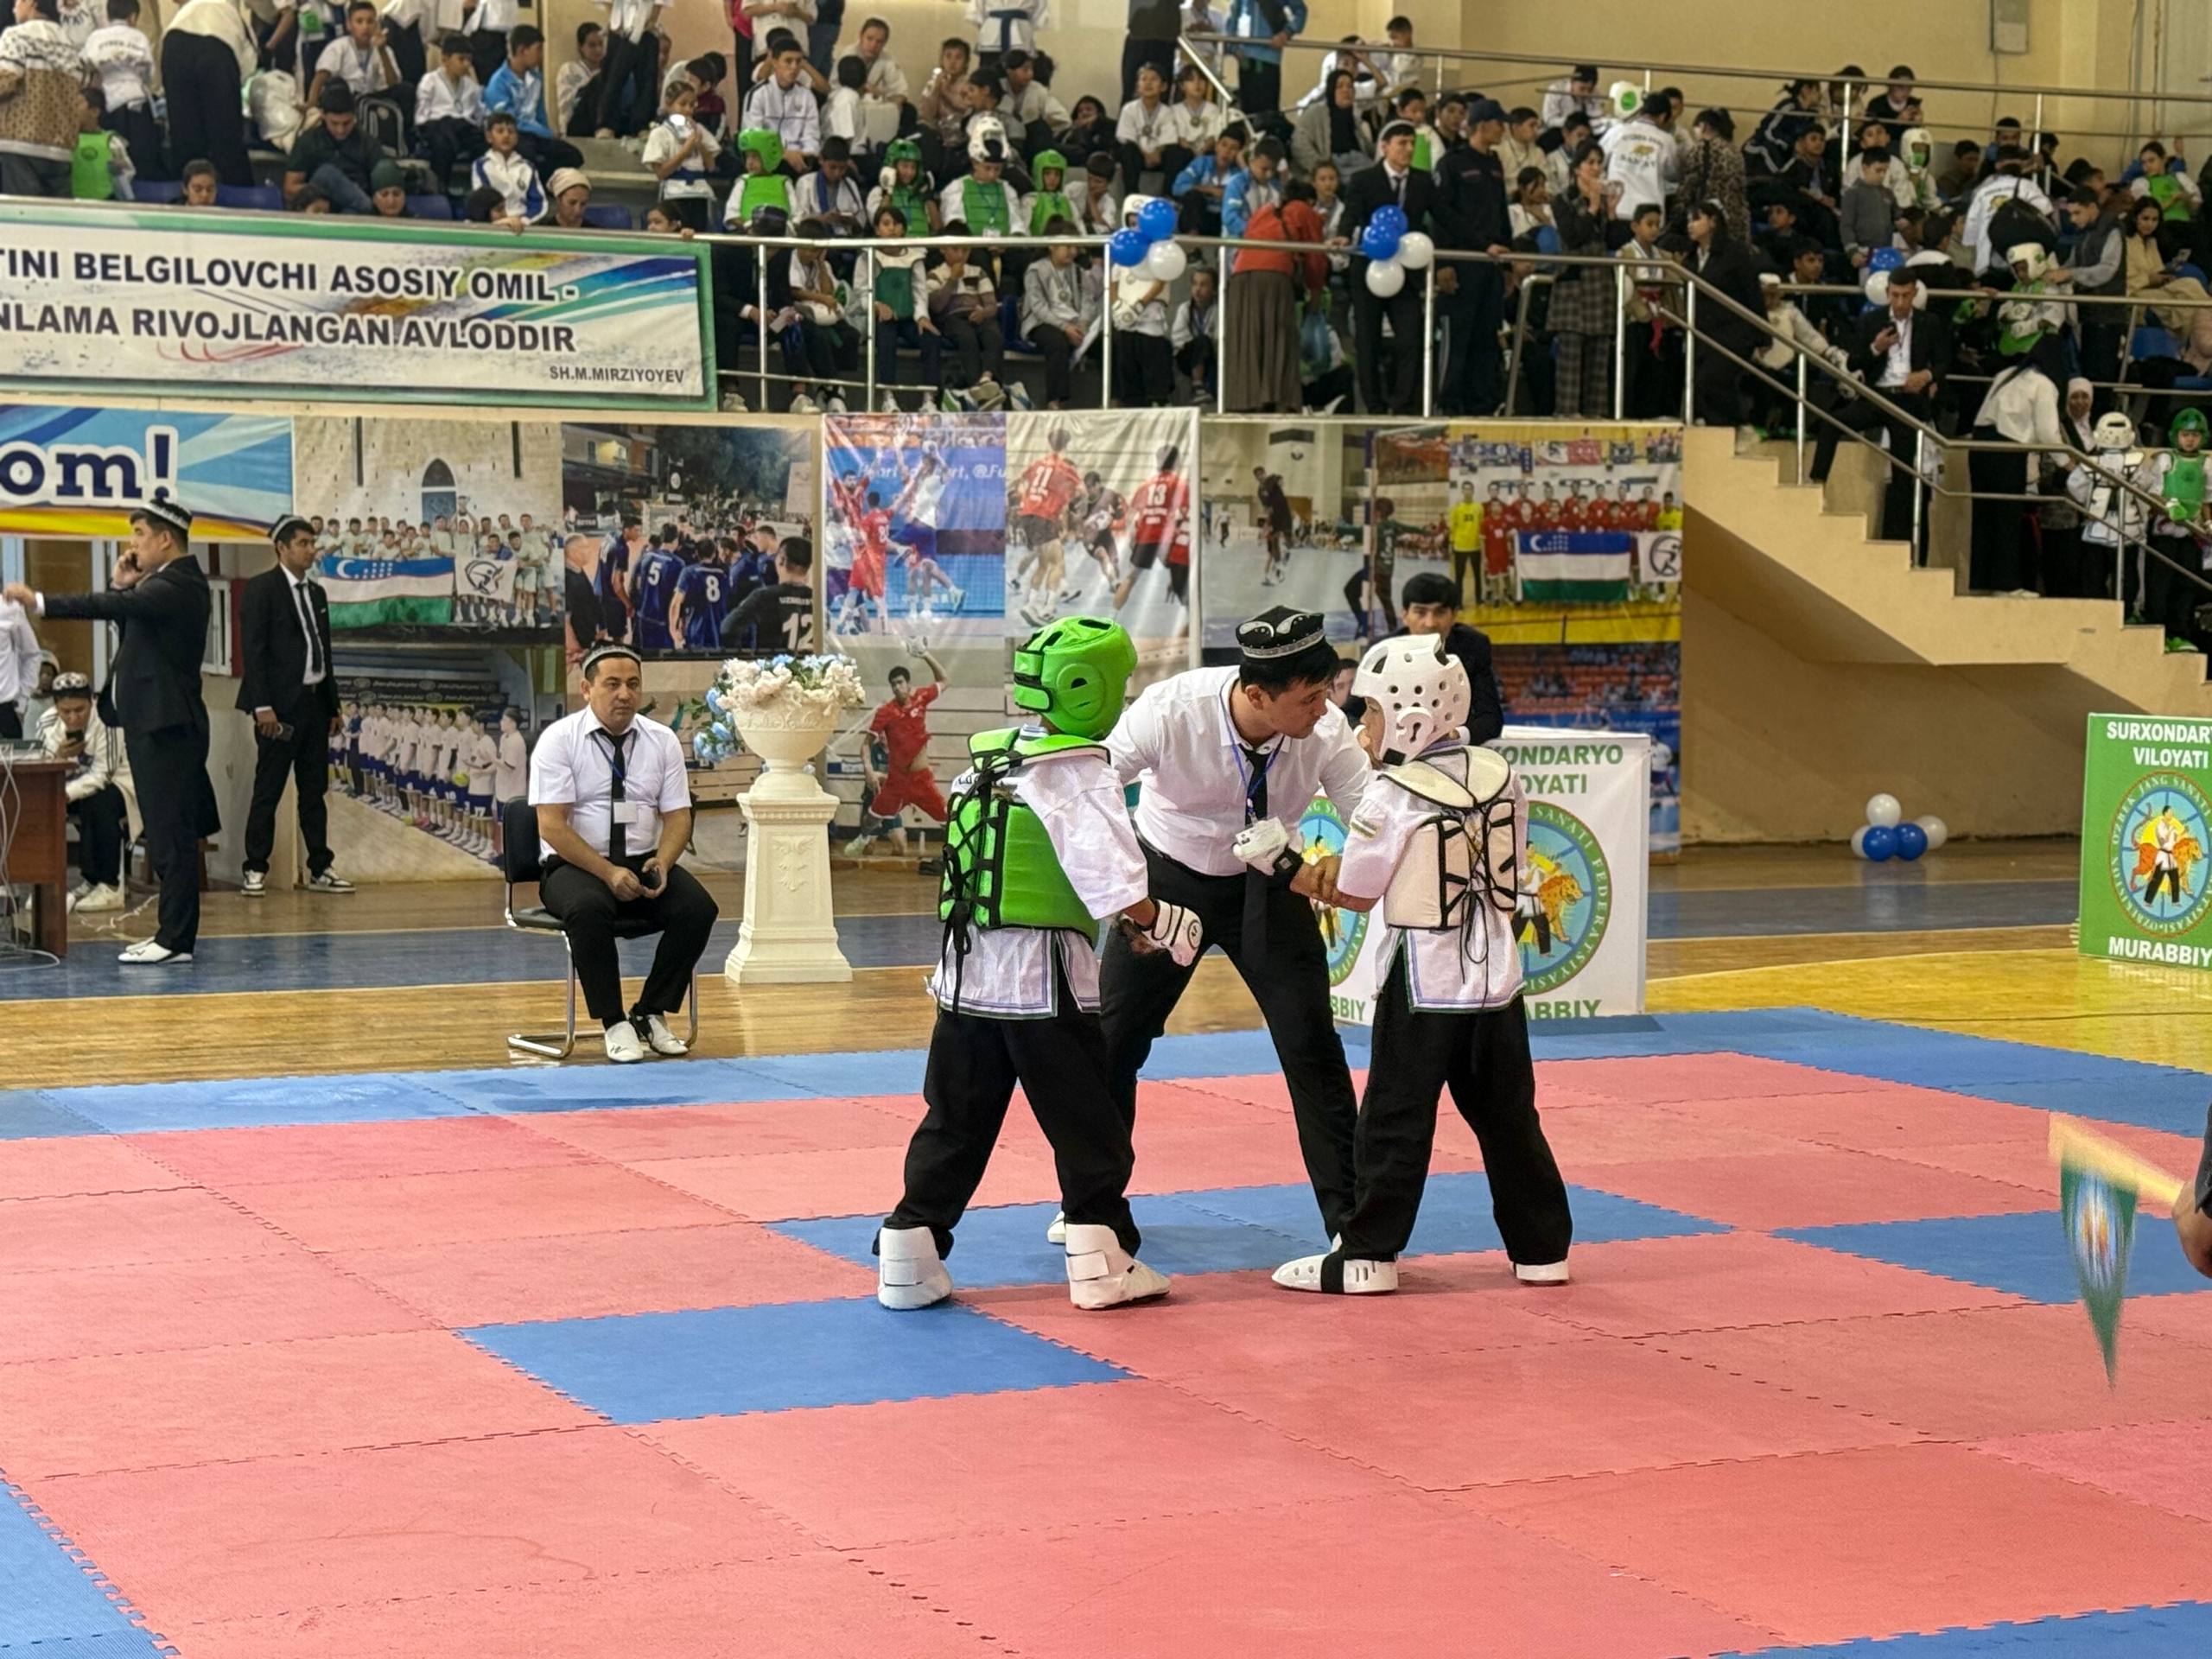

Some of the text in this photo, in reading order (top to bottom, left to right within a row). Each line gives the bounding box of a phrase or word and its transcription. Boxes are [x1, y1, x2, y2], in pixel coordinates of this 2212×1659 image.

[0, 249, 59, 278] INI
[74, 252, 316, 290] BELGILOVCHI
[330, 265, 458, 297] ASOSIY
[472, 271, 555, 301] OMIL
[133, 308, 391, 346] RIVOJLANGAN
[403, 319, 576, 352] AVLODDIR
[550, 366, 684, 383] SH.M.MIRZIYOYEV
[648, 562, 662, 586] 5
[706, 575, 721, 602] 8
[782, 612, 813, 651] 12
[2107, 721, 2212, 744] SURXONDAR
[2133, 747, 2209, 769] VILOYATI
[1530, 857, 1608, 991] FEDERATSIYASI
[2108, 936, 2212, 967] MURABBIY
